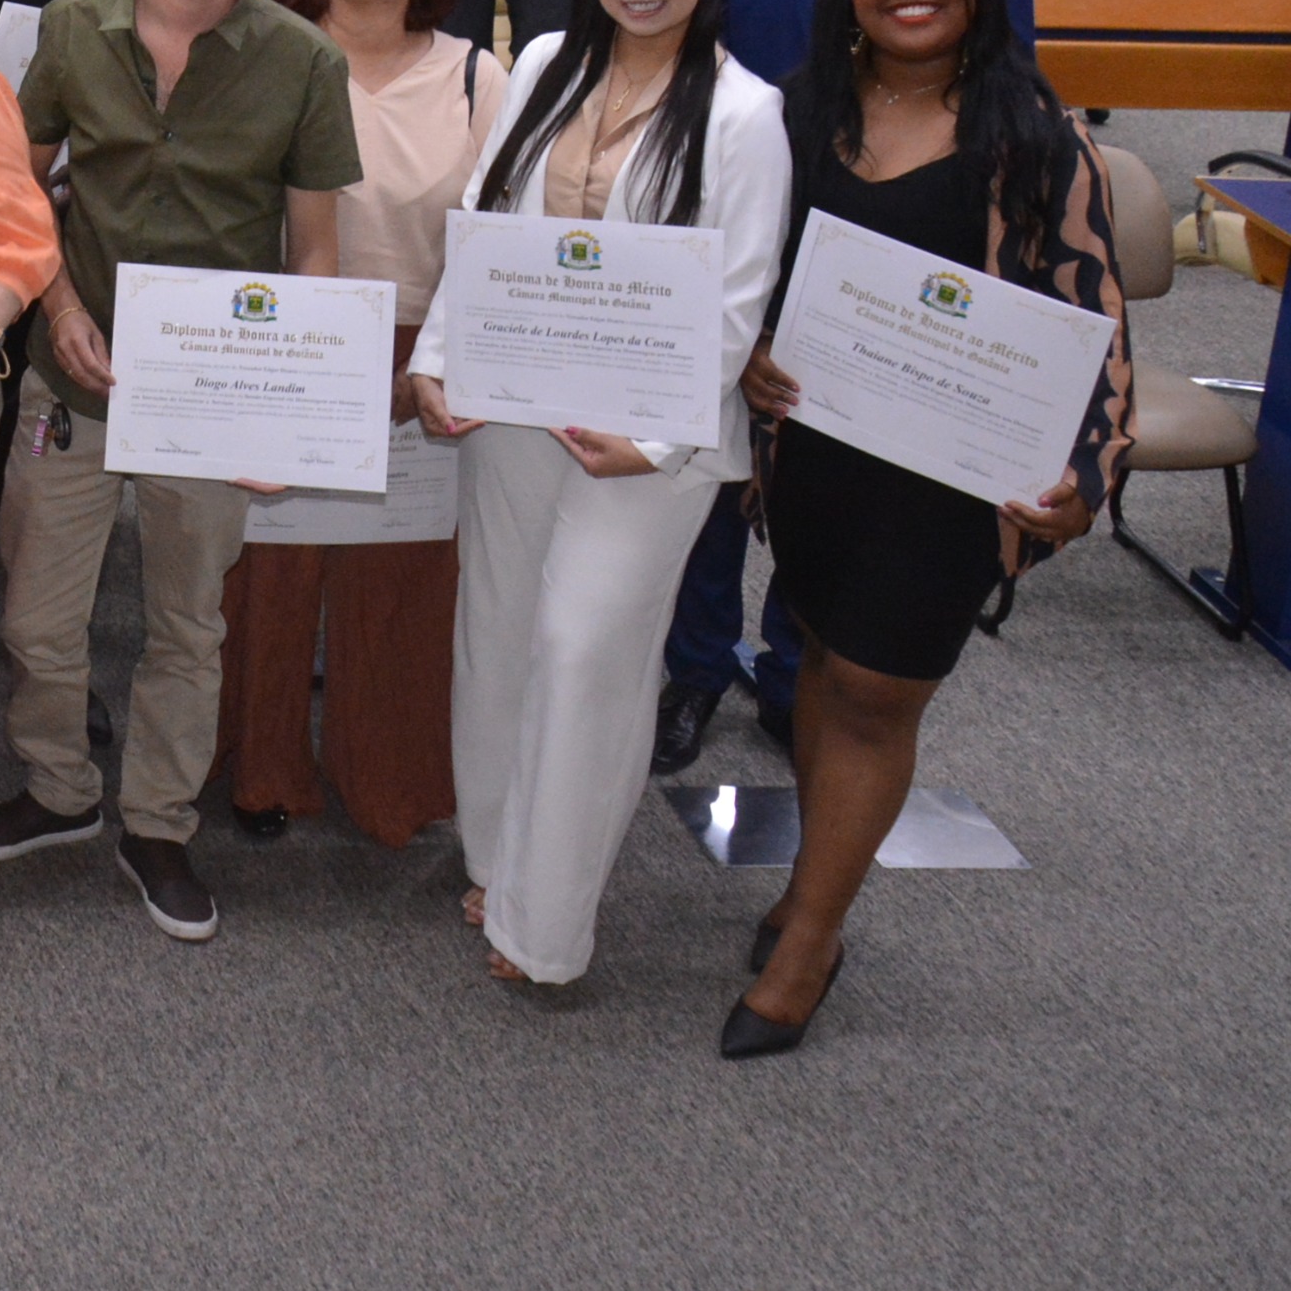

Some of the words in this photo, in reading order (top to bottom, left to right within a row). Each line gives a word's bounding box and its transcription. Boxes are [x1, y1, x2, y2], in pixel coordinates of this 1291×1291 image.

[487, 268, 541, 286] Diploma
[545, 274, 558, 286] de
[563, 275, 604, 291] Honra
[608, 282, 622, 292] ao
[626, 279, 672, 297] Mérito
[507, 287, 545, 300] Câmara
[547, 291, 596, 306] Municipal
[598, 297, 609, 306] de
[611, 296, 651, 309] Goiânia
[160, 322, 215, 338] Diploma
[219, 326, 233, 338] de
[238, 327, 278, 342] Honra
[282, 333, 296, 342] ao
[300, 331, 345, 346] Mérito
[483, 320, 527, 334] Graciele
[530, 325, 543, 336] de
[545, 326, 589, 340] Lourdes
[592, 331, 624, 346] Lopes
[627, 335, 641, 345] da
[644, 337, 676, 349] Costa
[837, 280, 898, 315] Diploma
[898, 304, 917, 321] de
[917, 311, 965, 341] Honra
[966, 334, 984, 348] ao
[986, 338, 1041, 370] Mérito
[854, 304, 896, 329] Câmara
[896, 321, 952, 352] Municipal
[951, 343, 966, 357] de
[965, 348, 1012, 375] Goiânia
[179, 341, 218, 352] Câmara
[220, 344, 269, 356] Municipal
[272, 348, 283, 356] de
[285, 347, 323, 359] Goiânia
[194, 377, 227, 390] Diogo
[229, 379, 259, 390] Alves
[263, 381, 305, 393] Landim
[850, 340, 899, 369] Thaiane
[899, 361, 935, 385] Bispo
[936, 376, 952, 390] de
[953, 382, 992, 406] Souza
